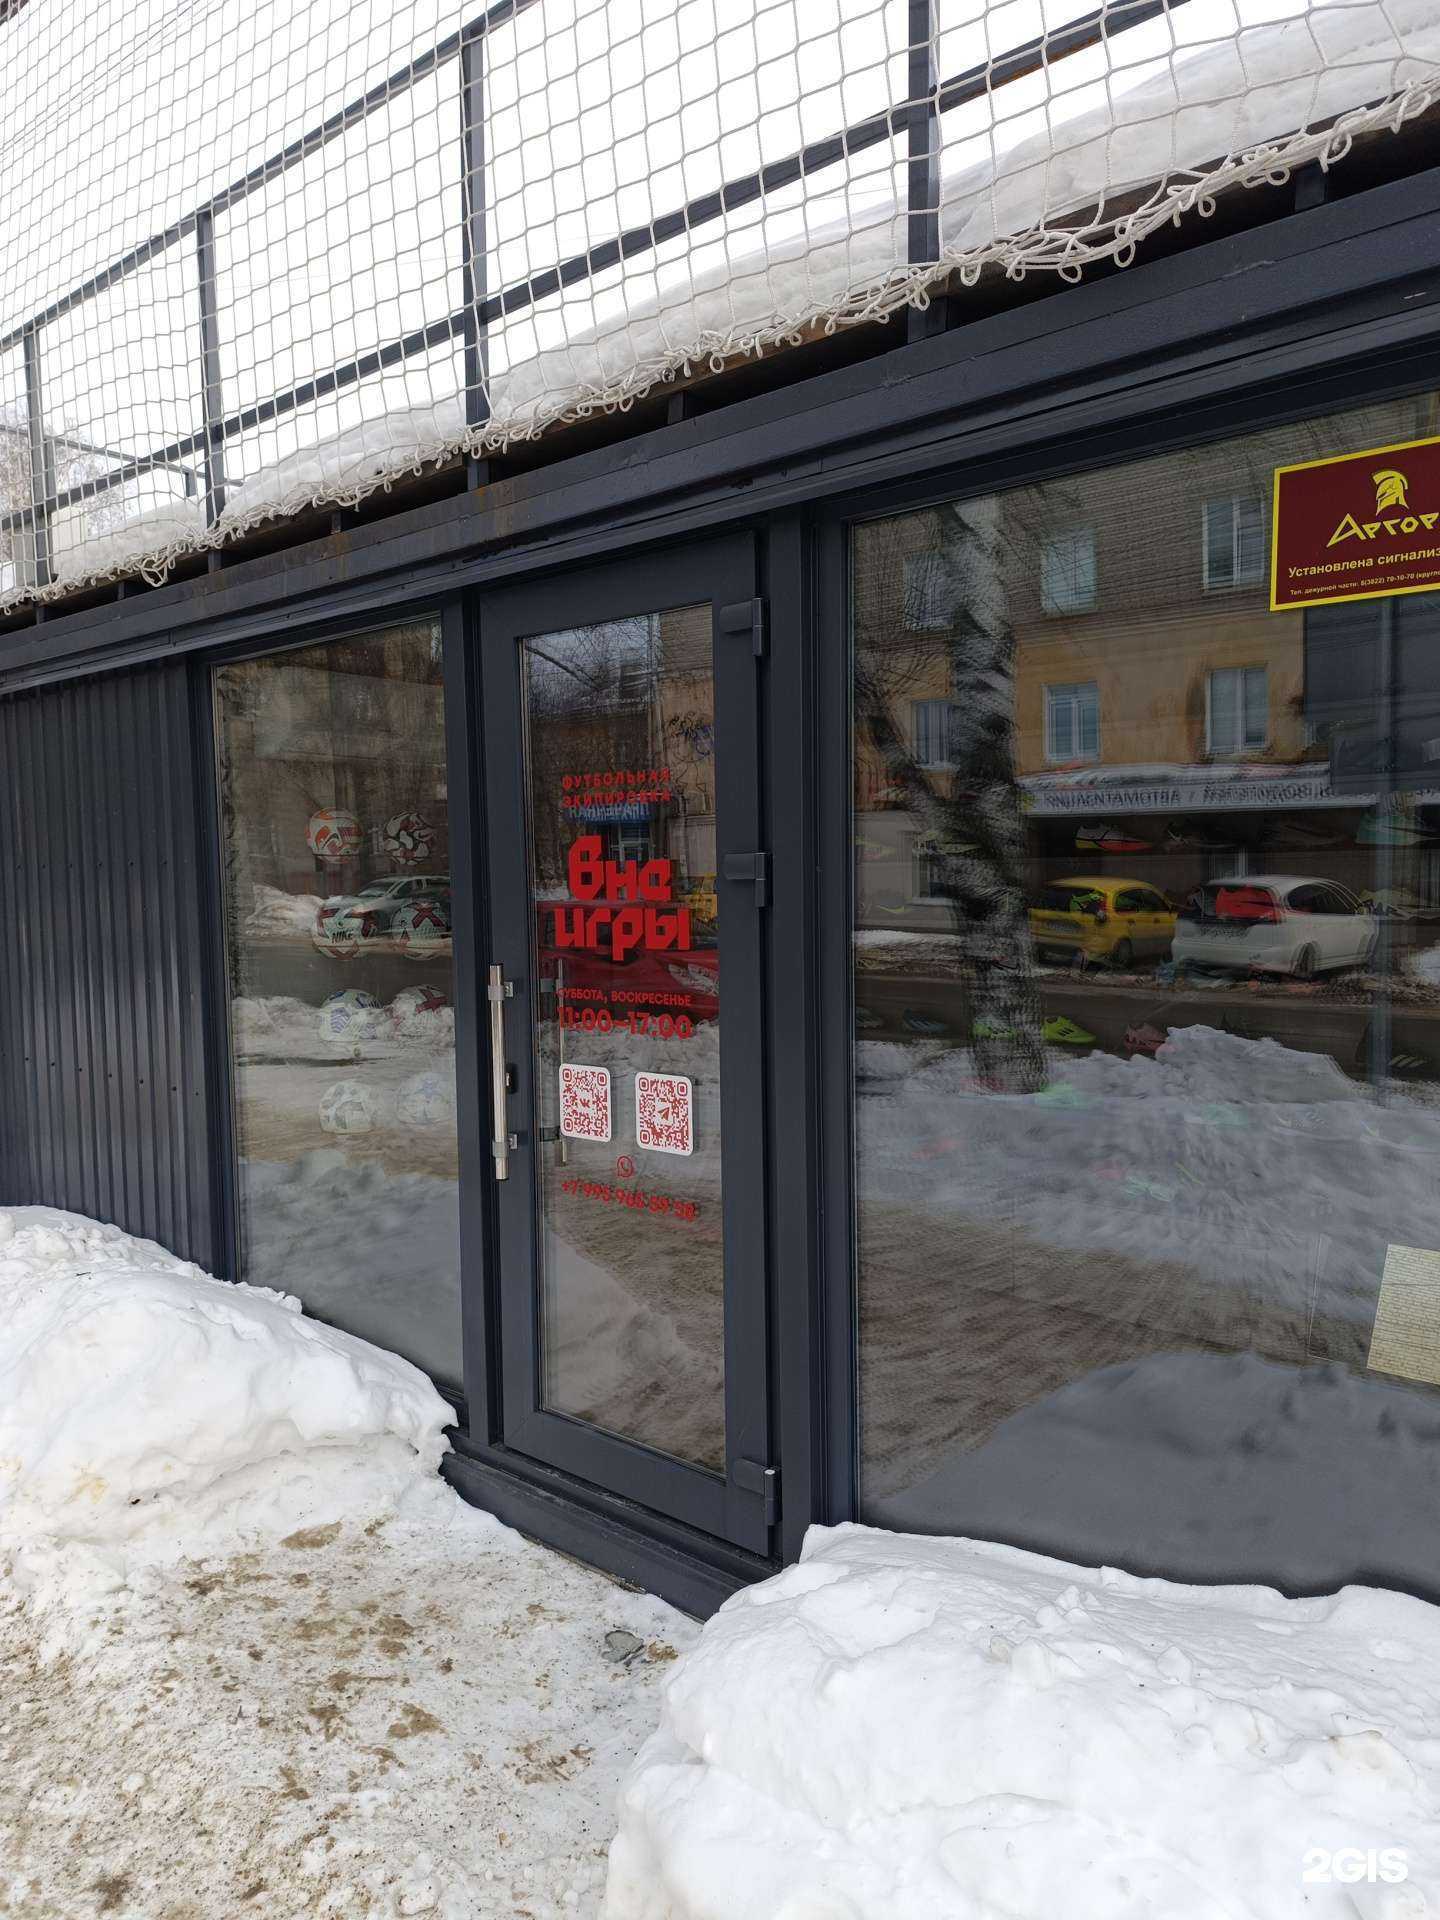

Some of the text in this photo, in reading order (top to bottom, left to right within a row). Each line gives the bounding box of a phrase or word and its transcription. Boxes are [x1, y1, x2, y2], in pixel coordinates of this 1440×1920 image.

[1288, 558, 1374, 578] Установлена
[561, 768, 671, 791] ФУТБОЛЬНАЯ
[331, 930, 354, 944] NIKE
[554, 907, 692, 961] игры
[611, 990, 692, 1007] ВОСКРЕСЕНЬЕ
